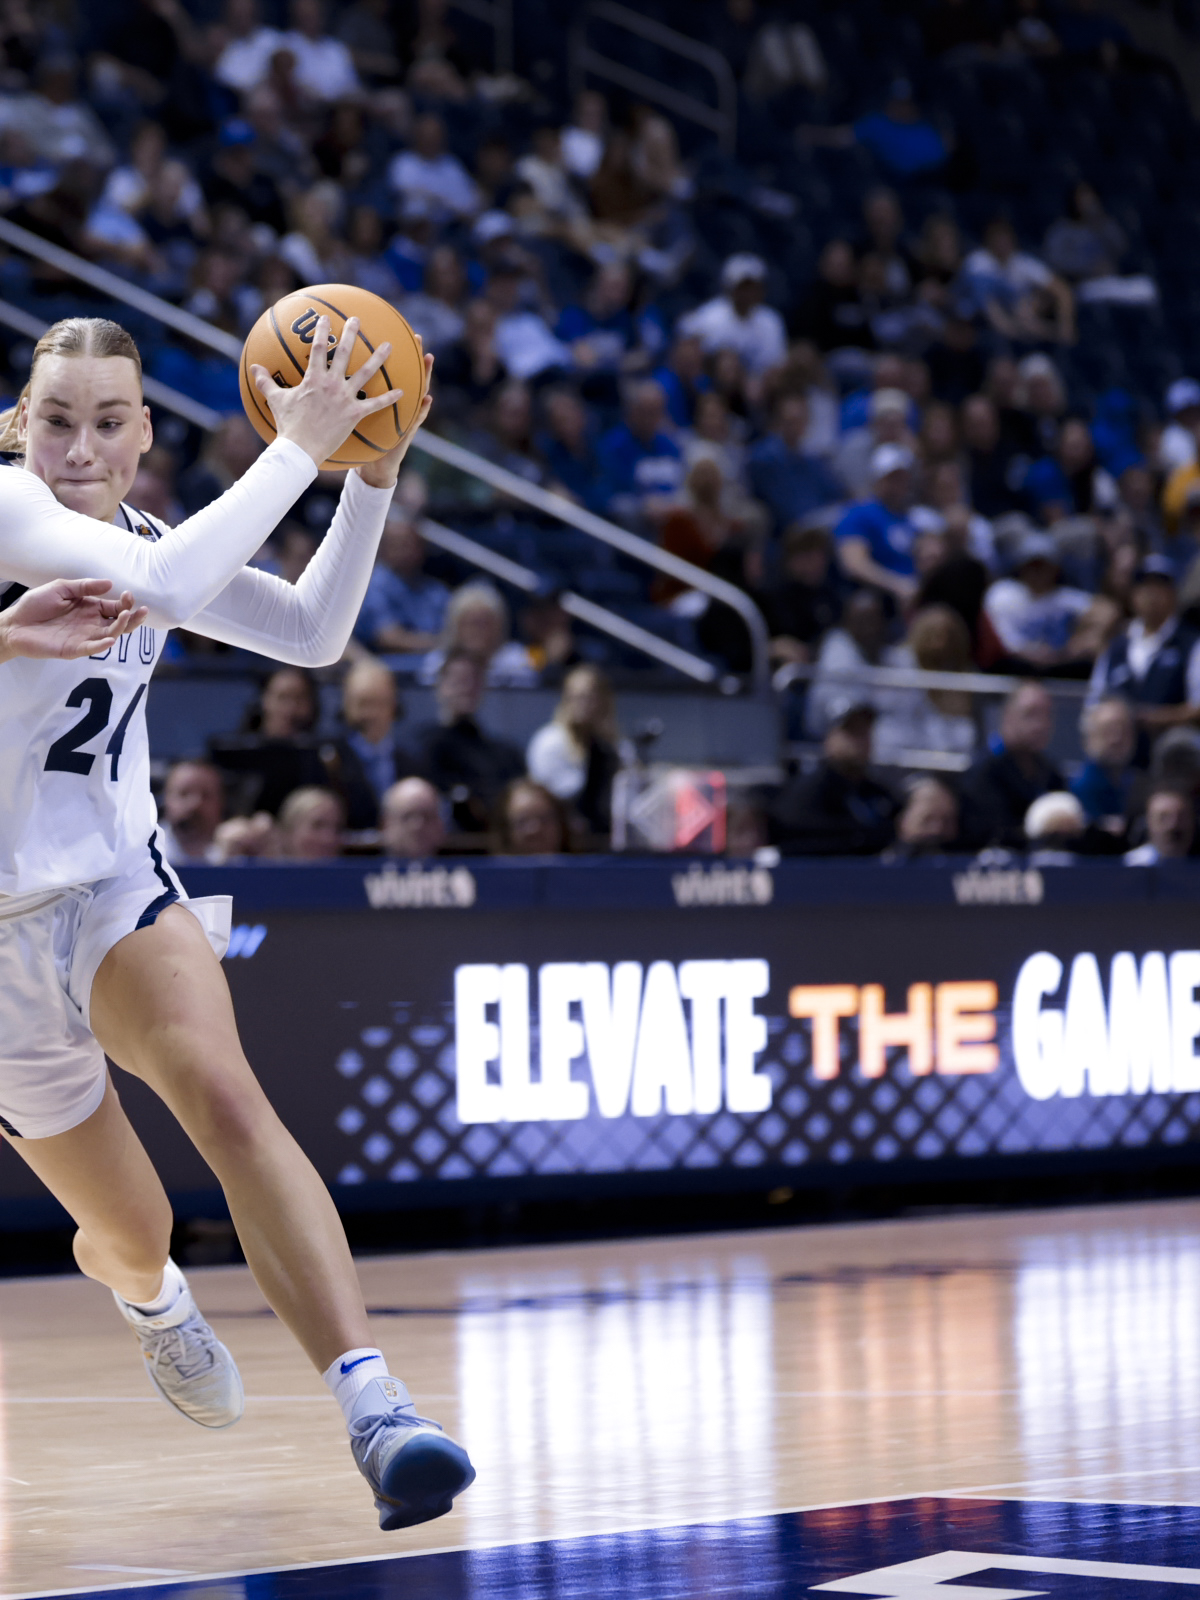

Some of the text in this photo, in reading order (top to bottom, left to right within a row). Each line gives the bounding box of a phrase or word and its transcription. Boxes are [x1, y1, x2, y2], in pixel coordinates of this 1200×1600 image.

[455, 950, 1200, 1124] ELEVATE THE GAME
